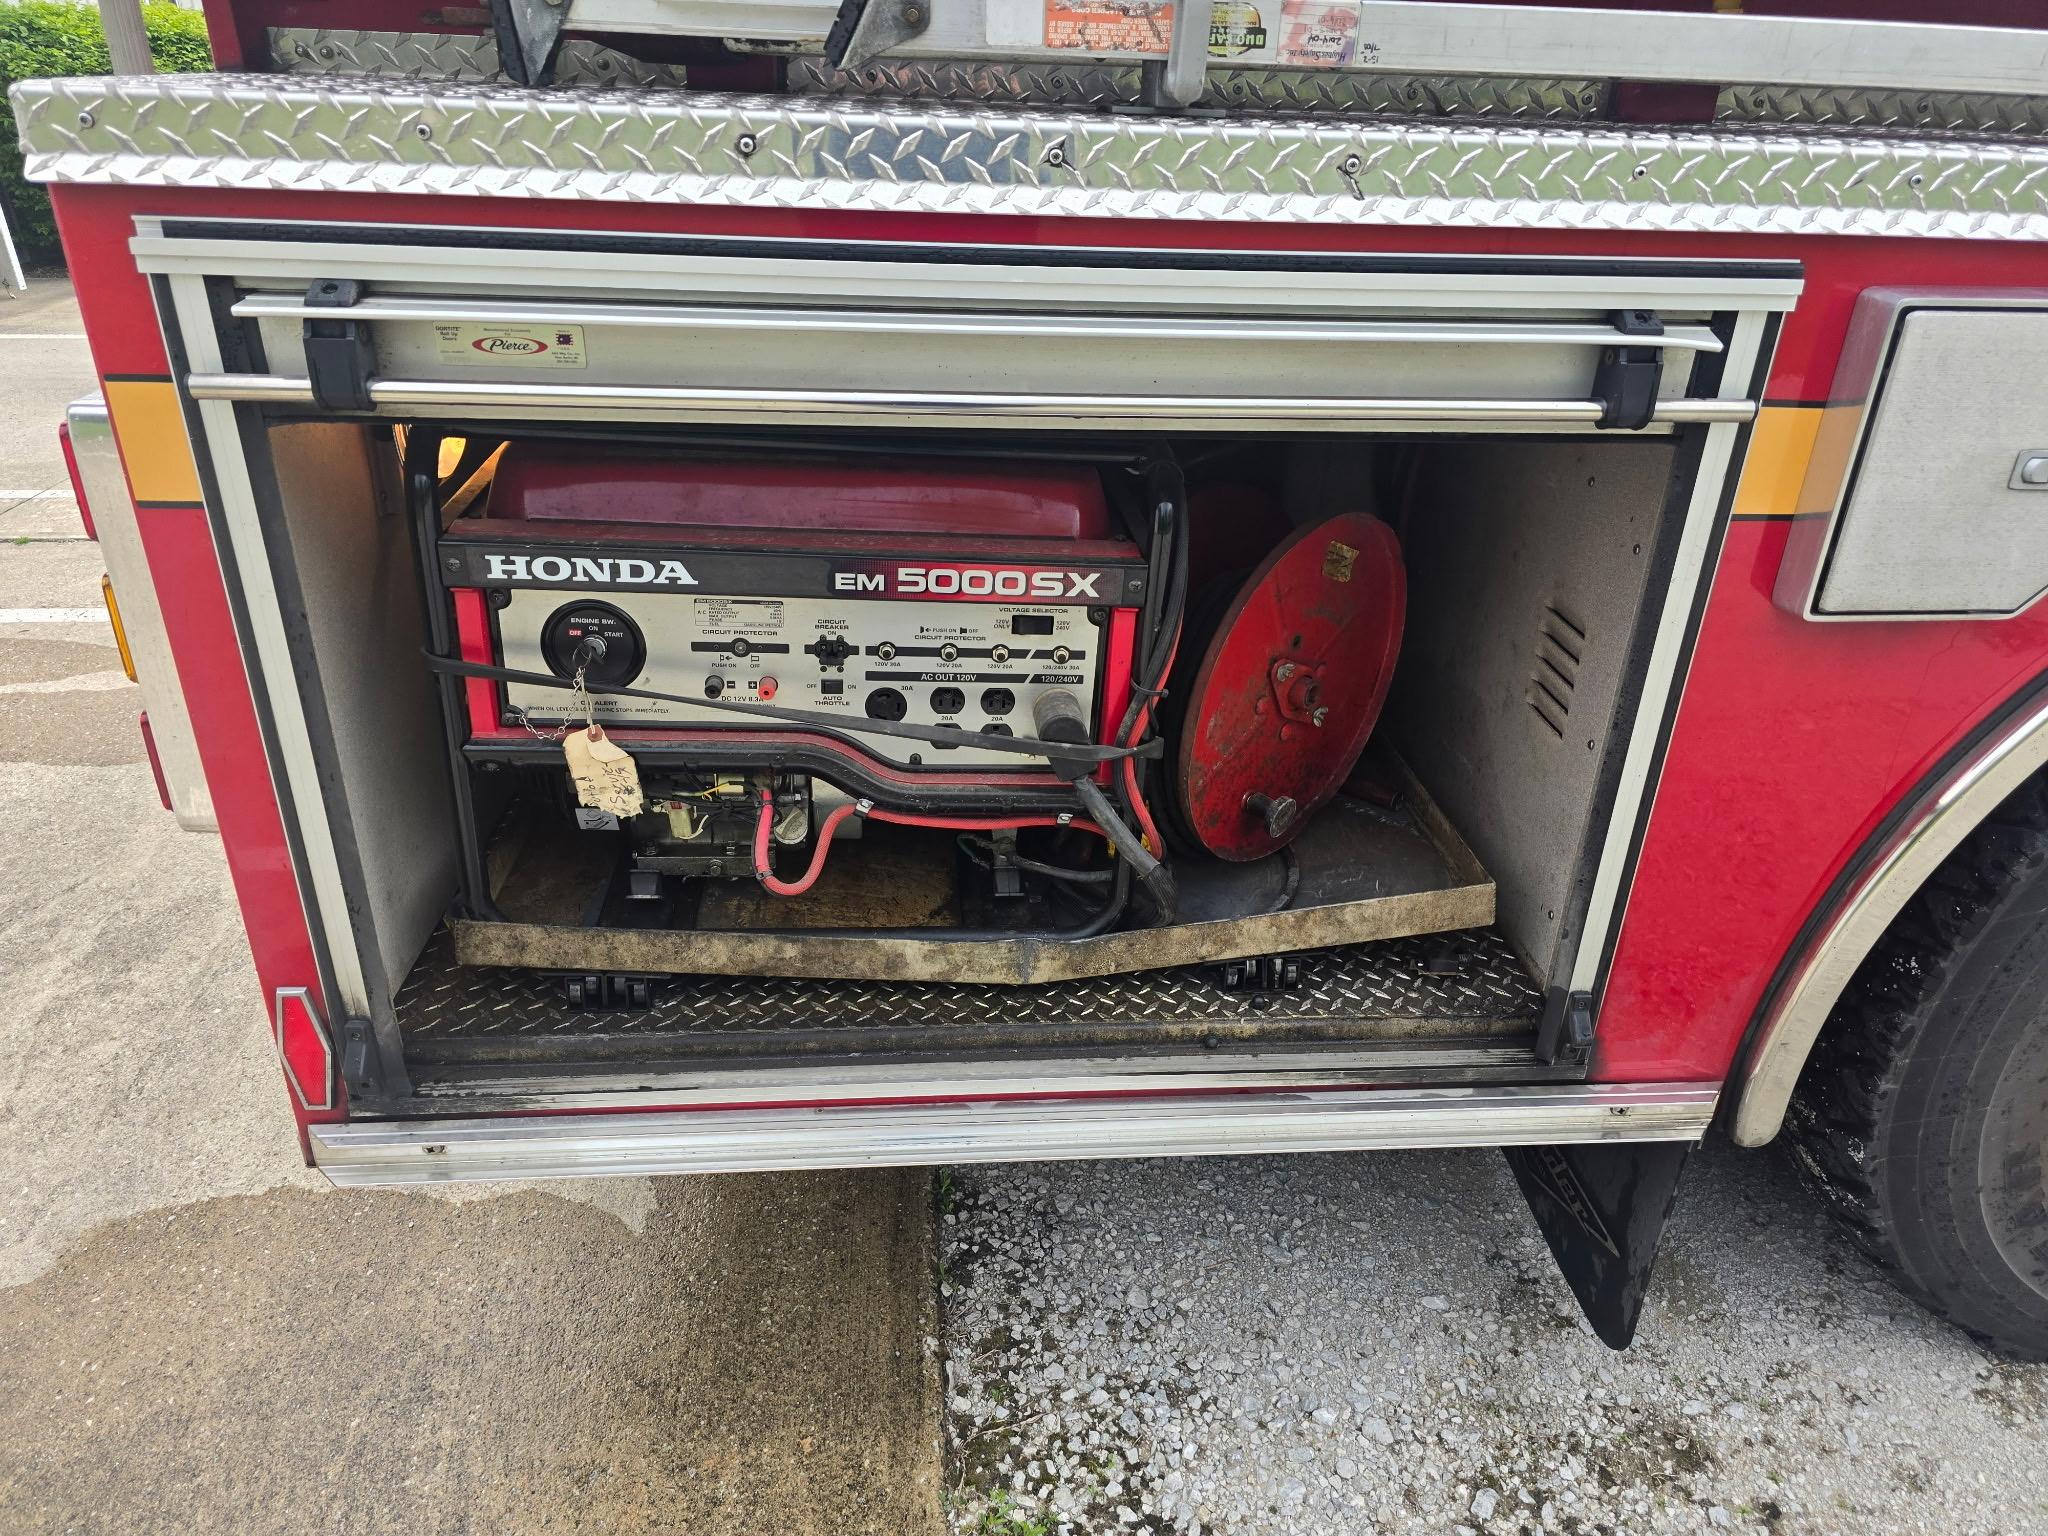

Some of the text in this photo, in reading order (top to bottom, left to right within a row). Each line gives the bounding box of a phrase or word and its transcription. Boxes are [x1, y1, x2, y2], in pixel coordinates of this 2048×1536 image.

[1209, 34, 1264, 45] DUO SAF
[490, 338, 530, 354] Pierce
[485, 555, 698, 585] HONDA
[834, 568, 1102, 598] EM 5000SX
[938, 673, 955, 681] OUT
